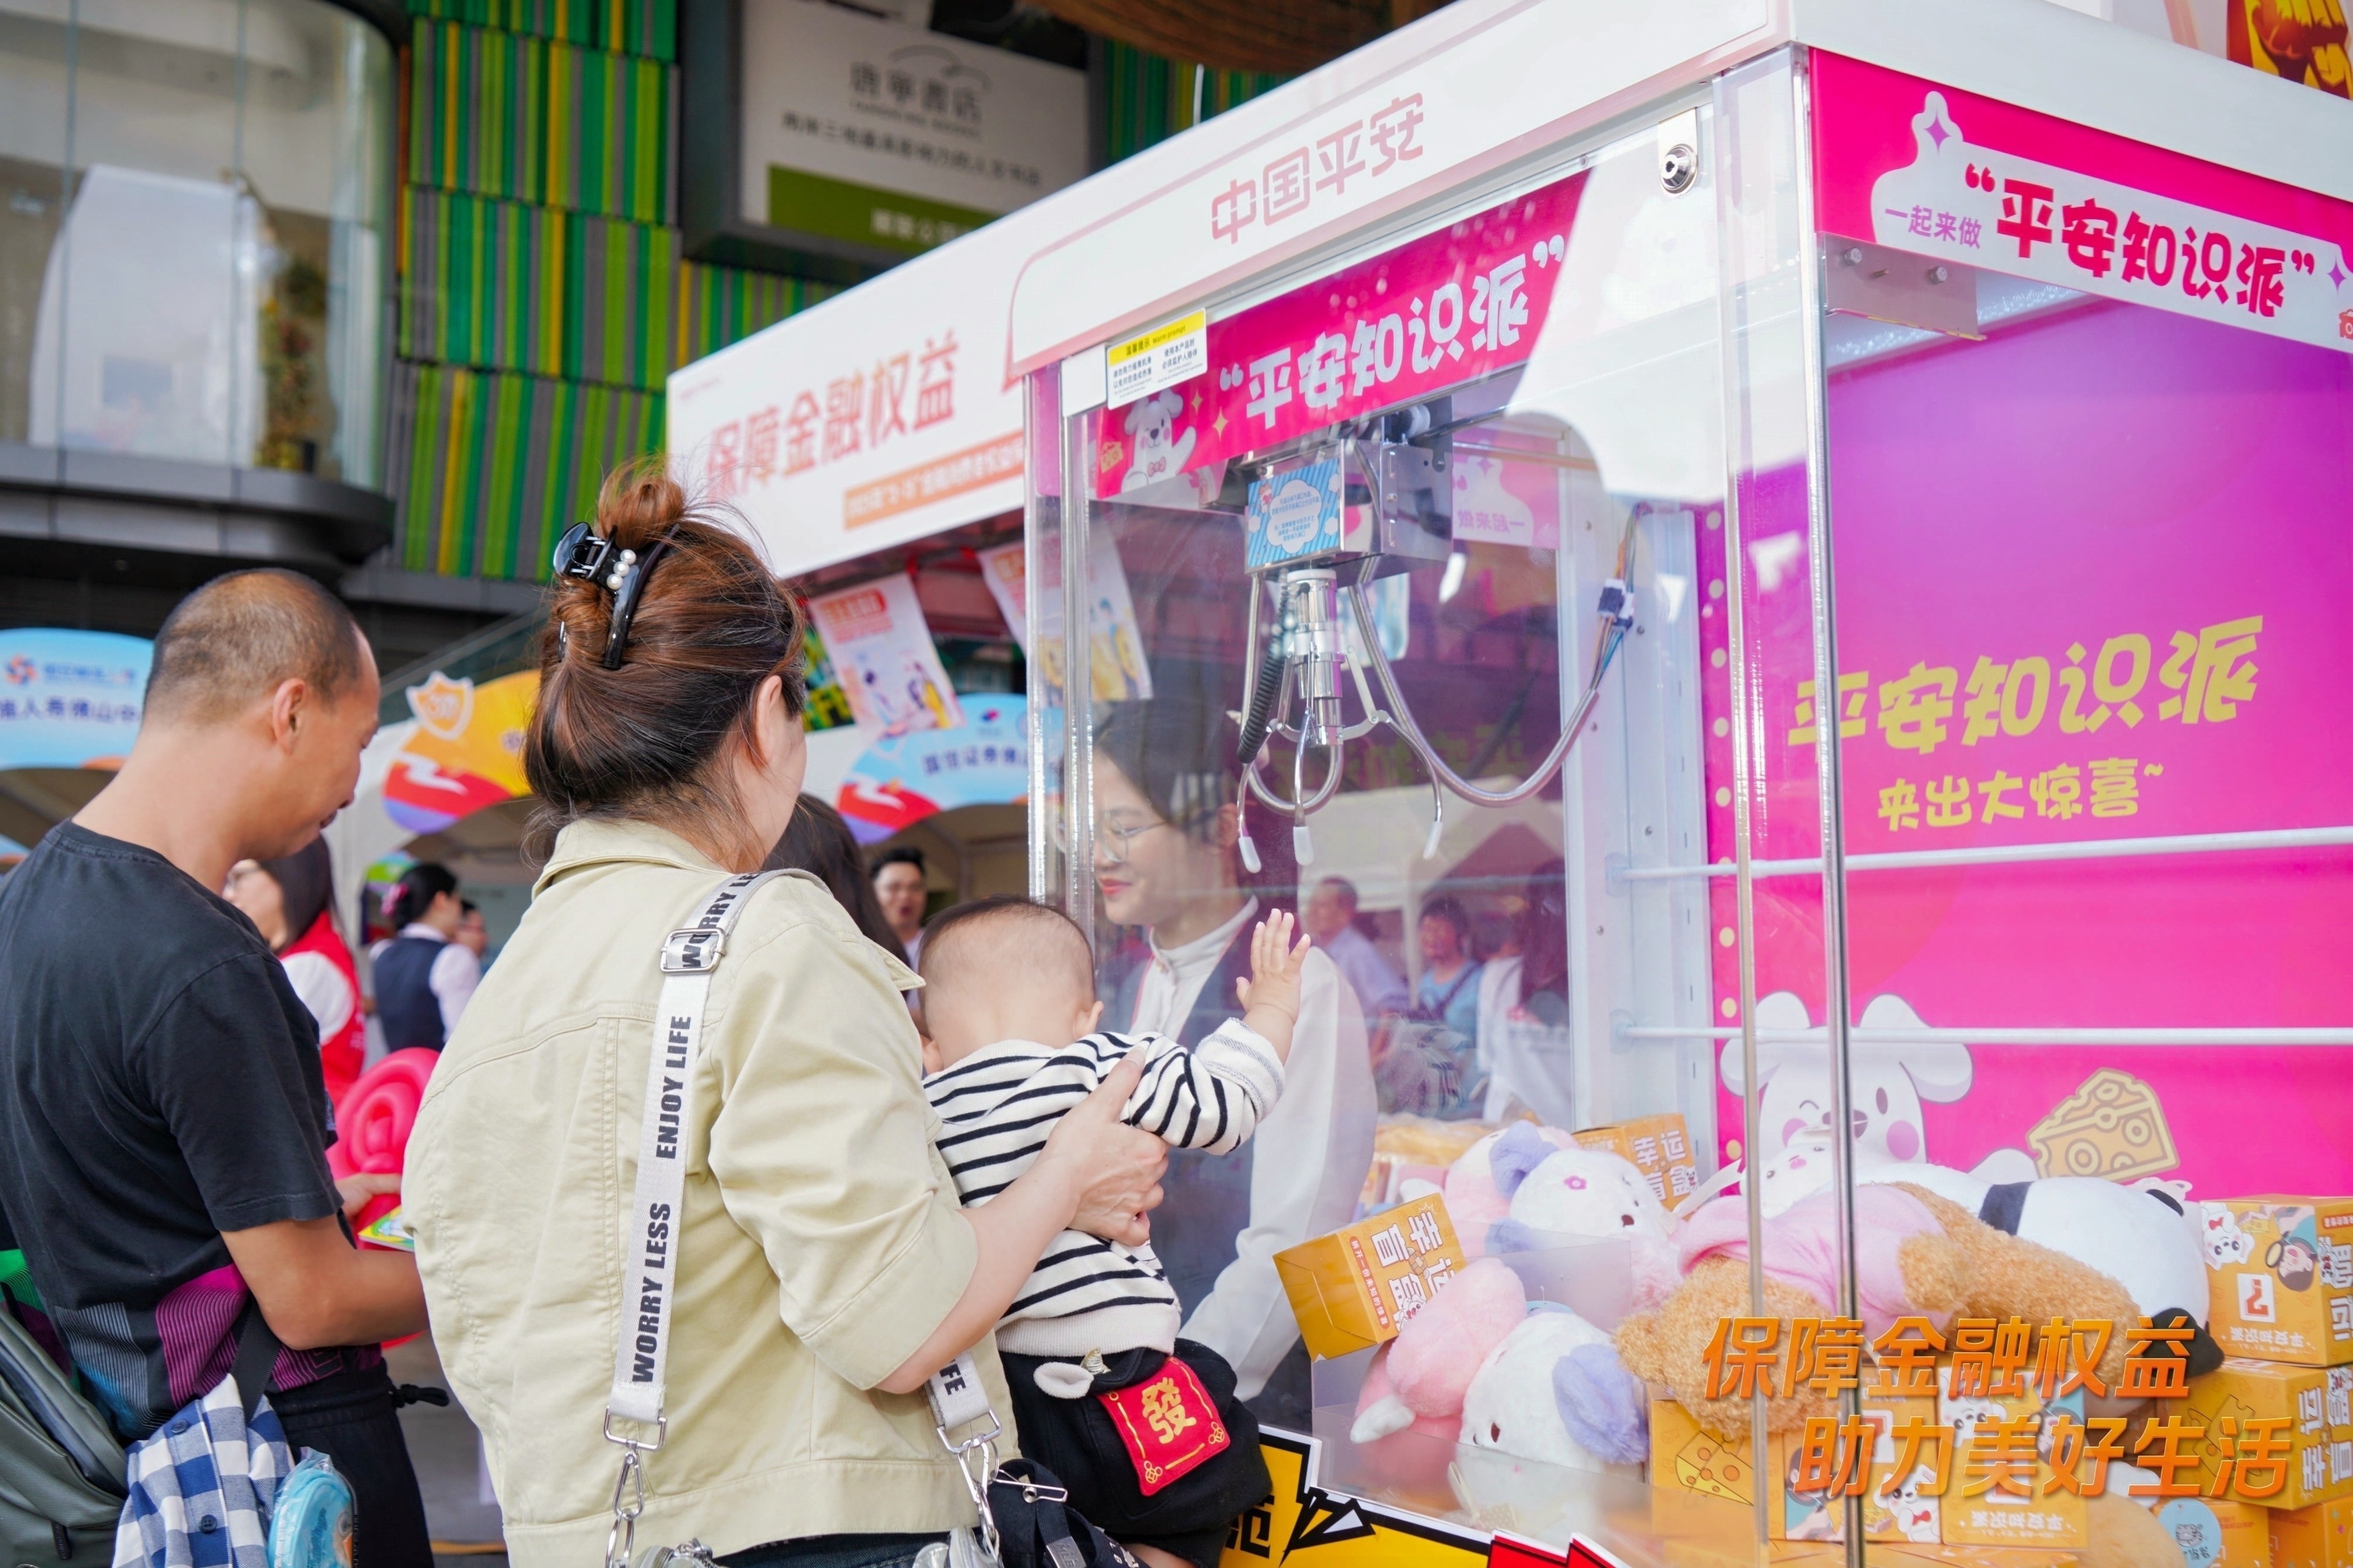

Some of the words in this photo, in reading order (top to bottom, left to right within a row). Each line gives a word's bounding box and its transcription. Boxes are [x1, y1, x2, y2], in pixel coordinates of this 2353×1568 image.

[1211, 92, 1424, 244] 中国平安
[1885, 205, 1982, 249] 一起来做
[1219, 234, 1565, 430] “平安知识派”
[707, 327, 959, 501] 保障金融权益
[1787, 615, 2264, 764] 平安知识派
[665, 1016, 691, 1069] LIFE
[656, 1076, 684, 1160] ENJOY
[1634, 1128, 1686, 1168] 幸运
[644, 1201, 671, 1269] LESS
[1350, 1239, 1389, 1327] 拆开一份未知的惊喜
[632, 1276, 665, 1383] WORRY
[1141, 1376, 1197, 1445] 發
